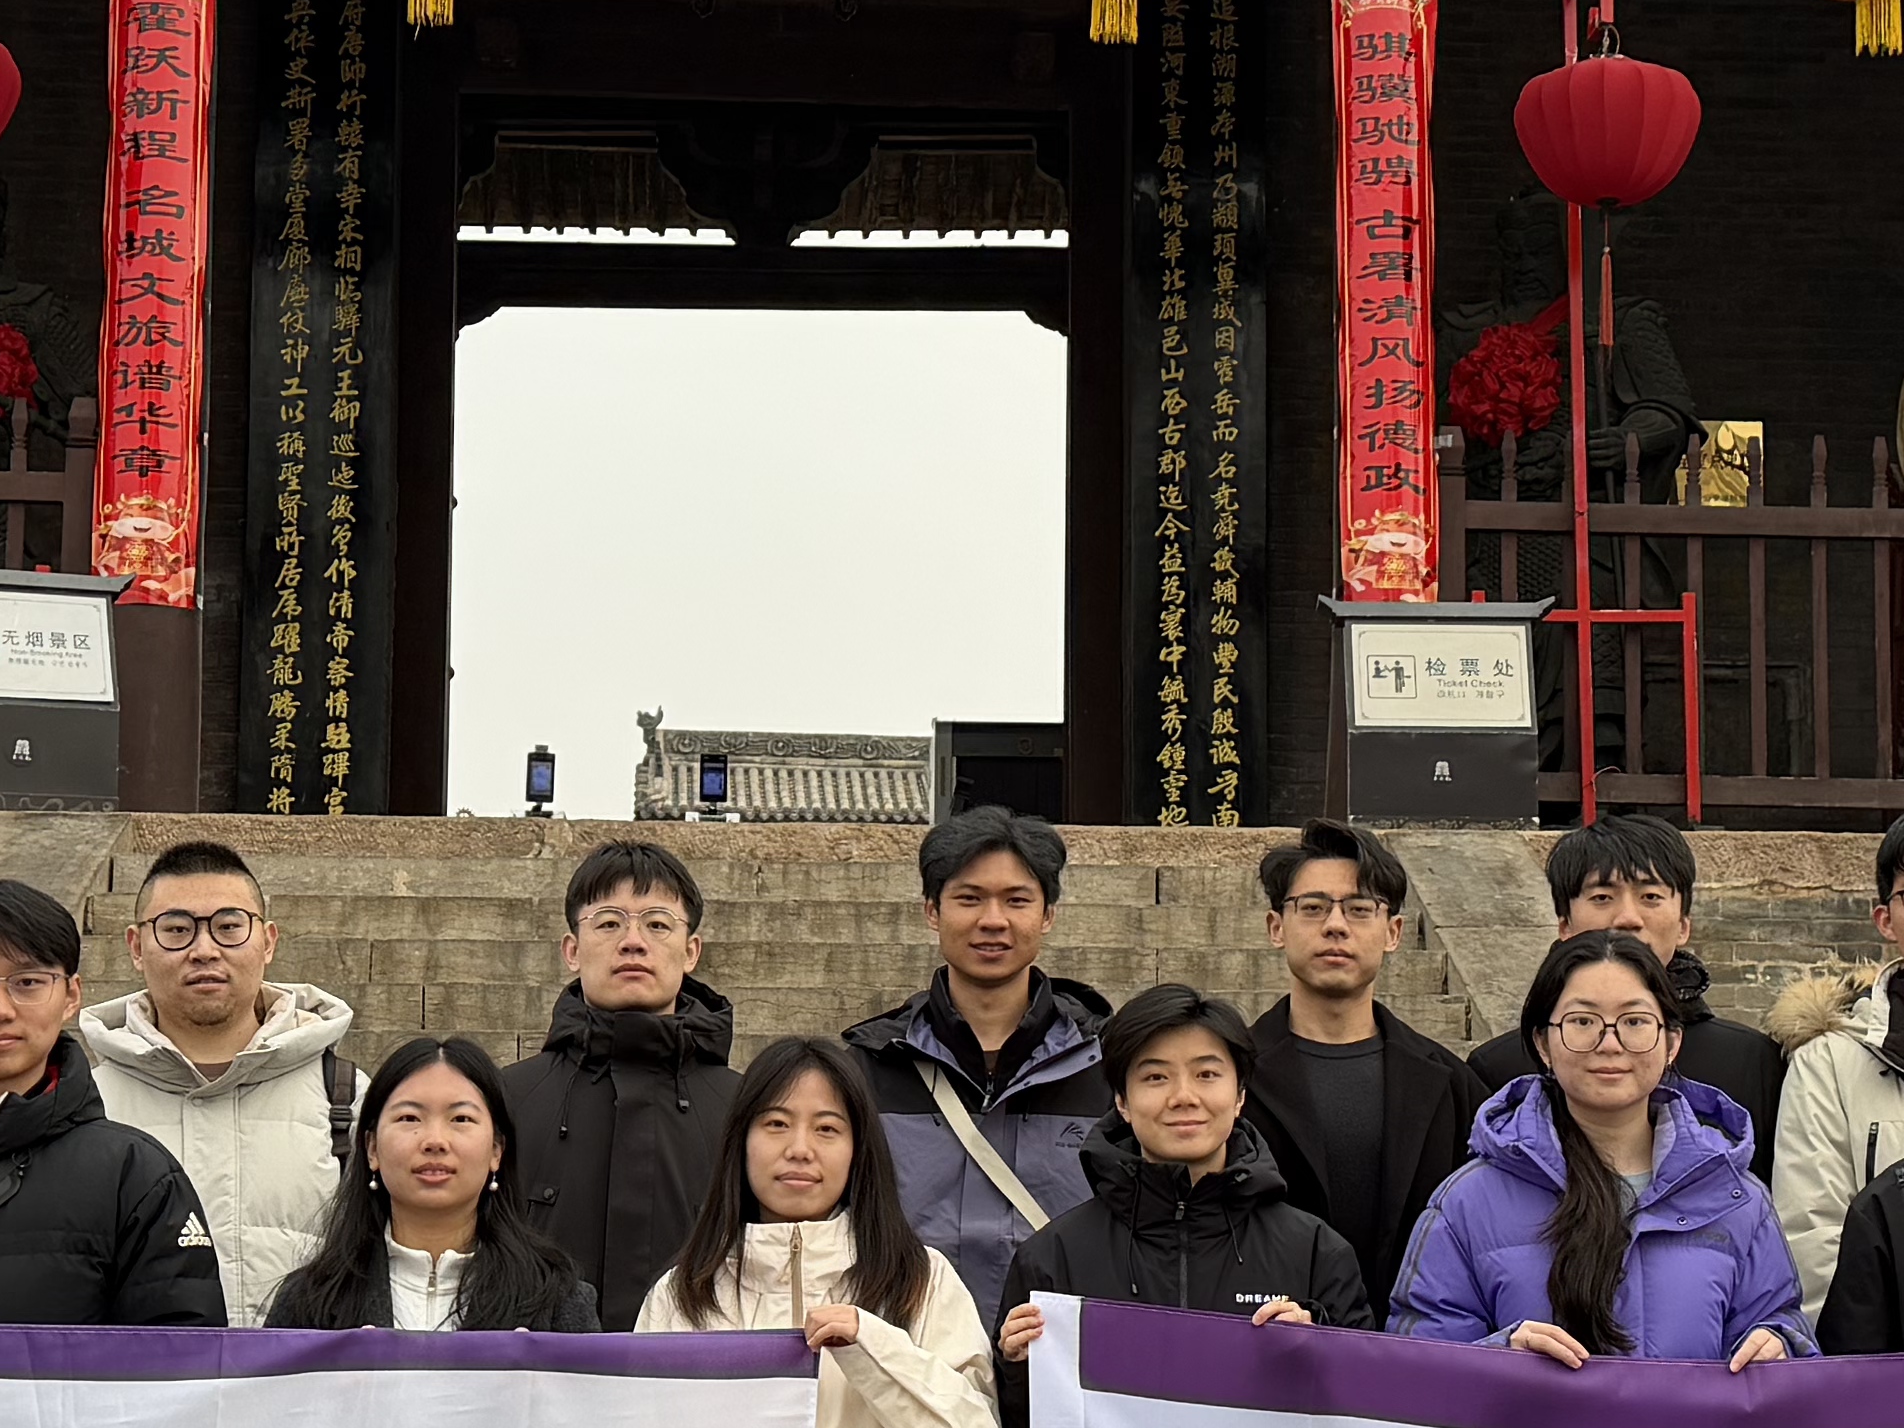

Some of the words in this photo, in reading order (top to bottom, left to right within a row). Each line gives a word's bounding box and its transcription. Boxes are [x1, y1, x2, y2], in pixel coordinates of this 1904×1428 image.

[1, 629, 91, 650] 无烟景区
[1424, 656, 1515, 678] 检票处
